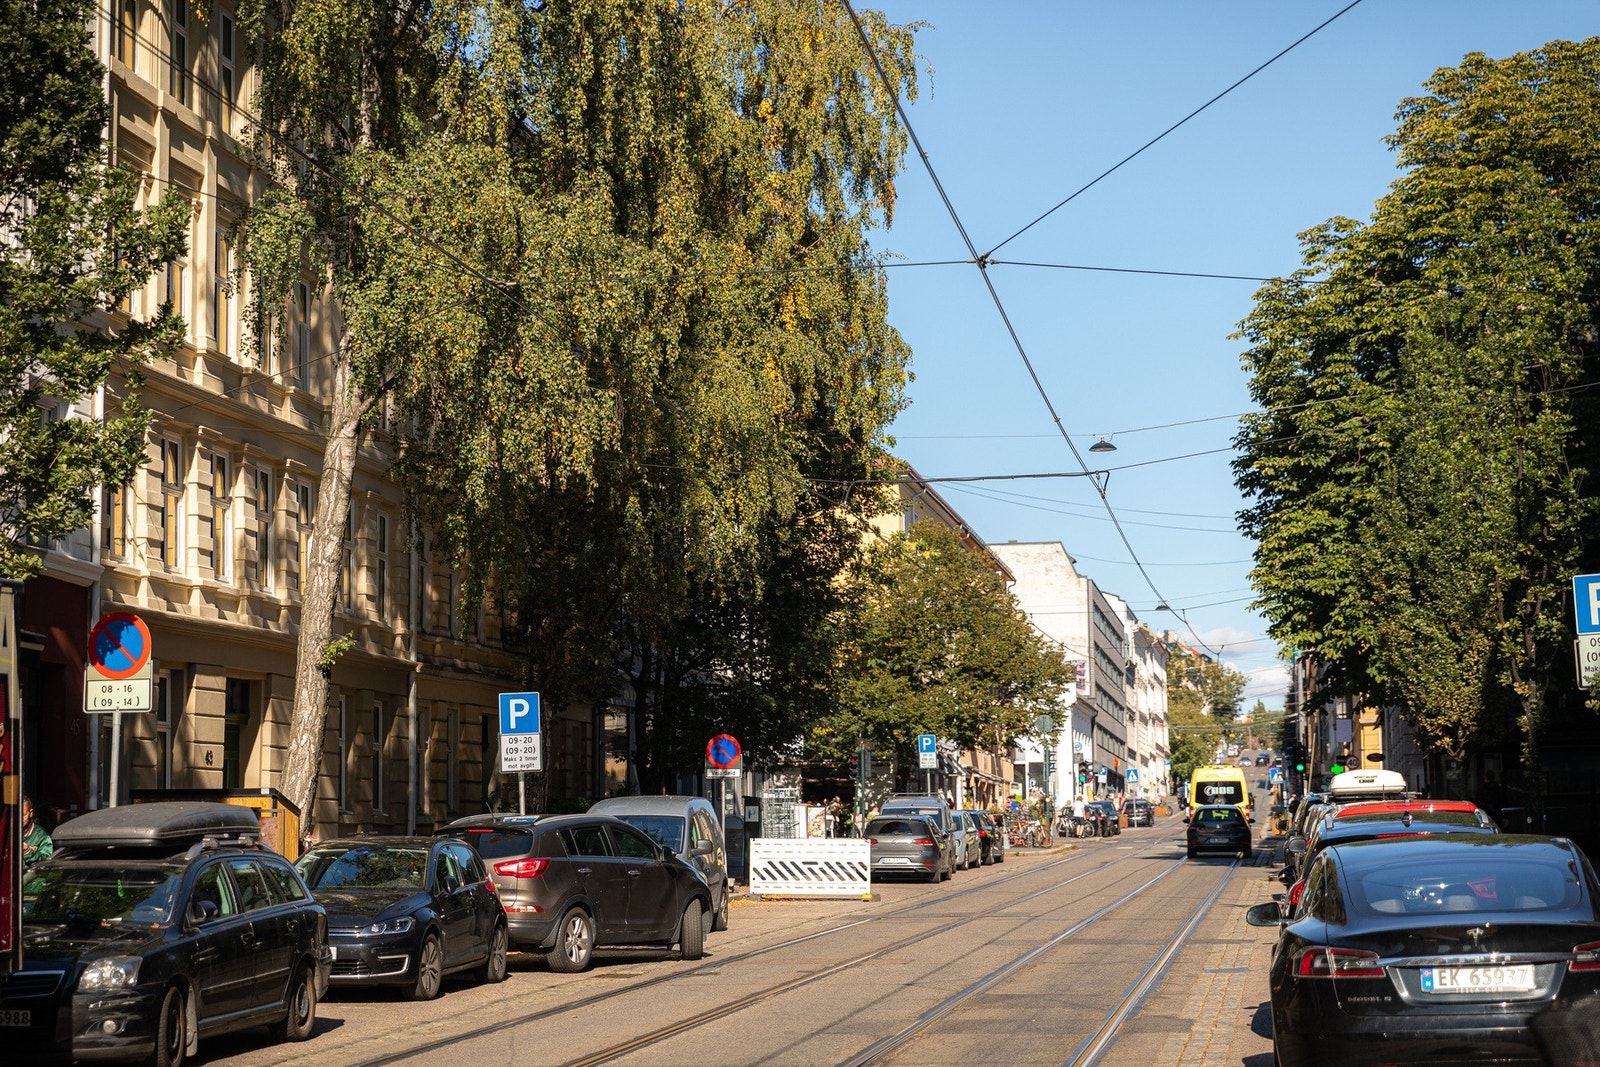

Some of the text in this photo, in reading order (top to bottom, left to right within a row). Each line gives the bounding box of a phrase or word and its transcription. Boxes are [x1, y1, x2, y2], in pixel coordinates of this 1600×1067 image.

[101, 685, 113, 693] 08
[124, 685, 133, 693] 16
[509, 698, 530, 729] P
[922, 737, 932, 750] P
[1438, 967, 1528, 986] EK 65937
